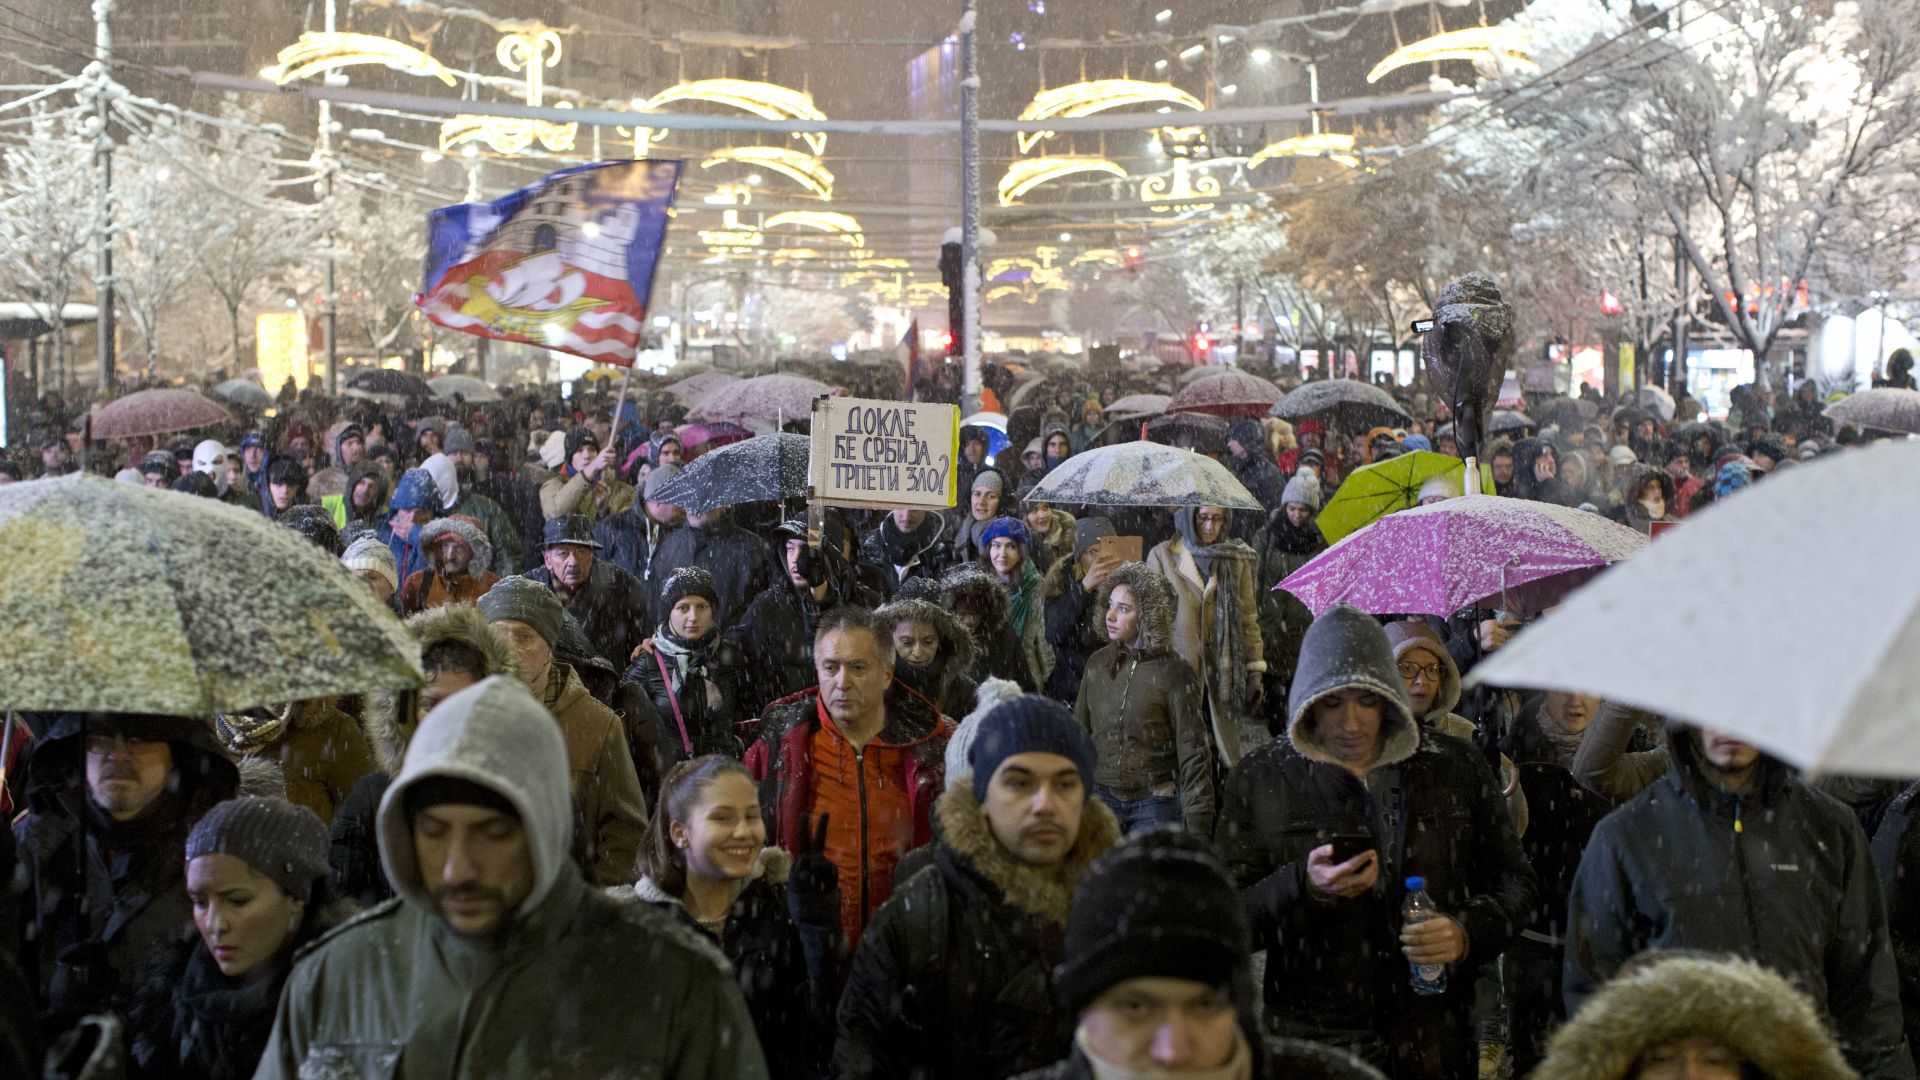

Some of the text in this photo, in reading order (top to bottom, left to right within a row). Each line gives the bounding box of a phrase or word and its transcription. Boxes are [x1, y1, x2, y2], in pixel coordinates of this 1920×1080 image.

[845, 406, 917, 438] ДОКЛЕ
[834, 435, 931, 465] ЋЕ СРБИЈА
[831, 454, 949, 495] ТРПЕТИ ЗЛО?
